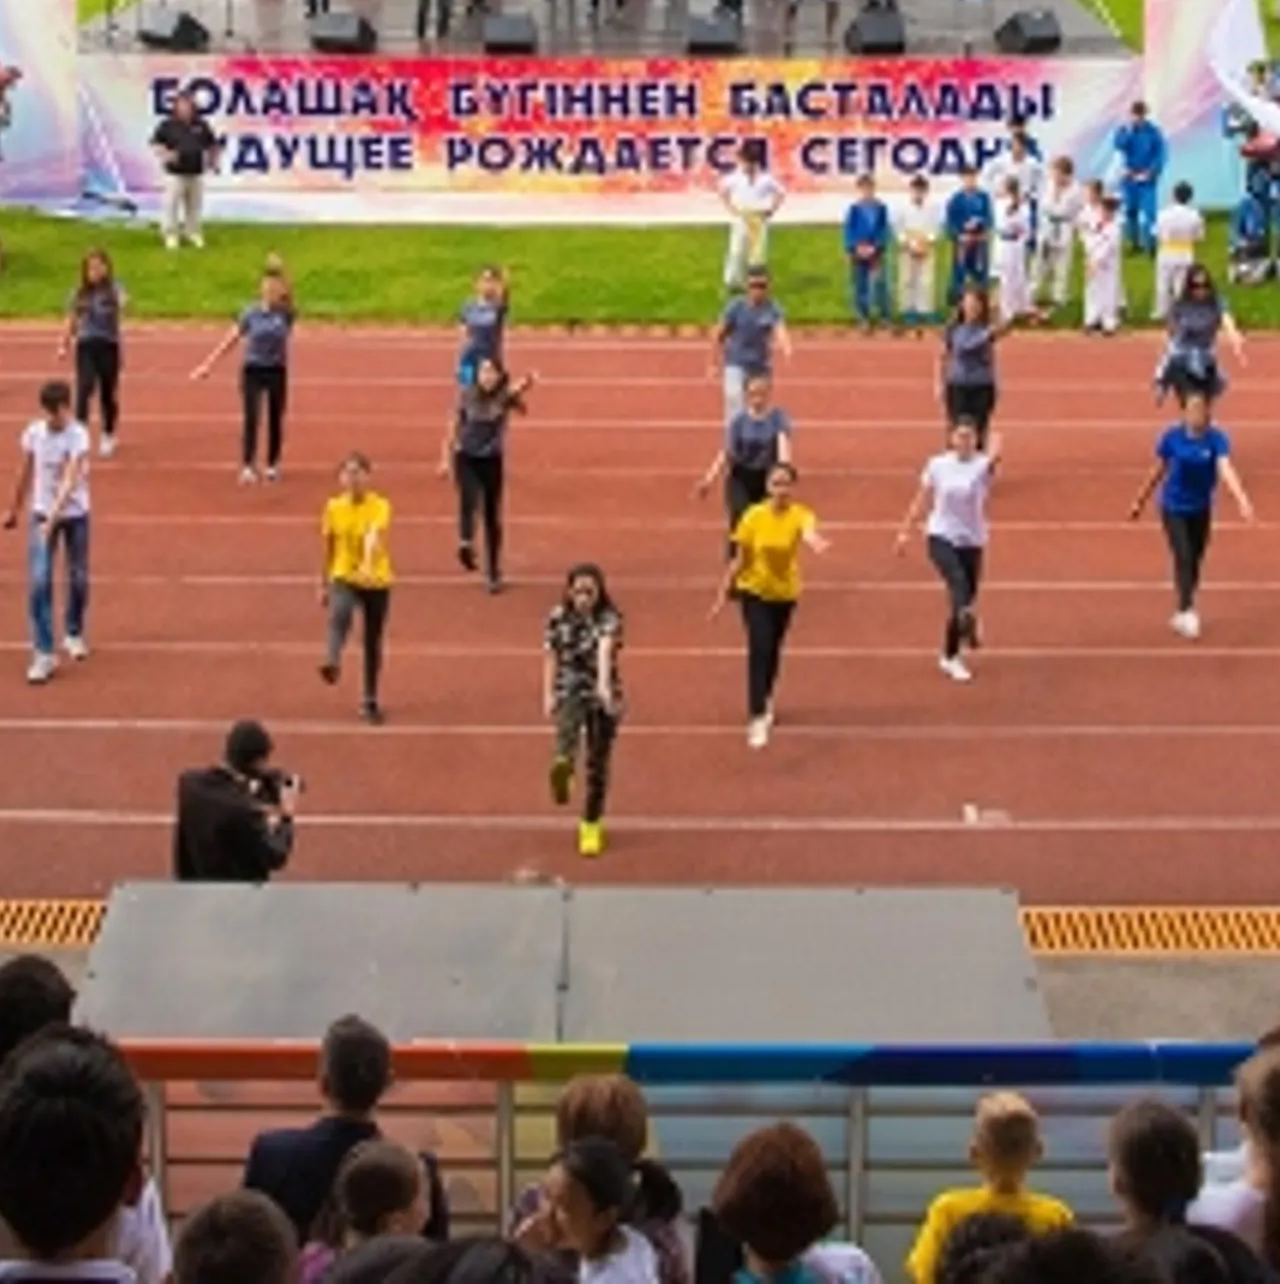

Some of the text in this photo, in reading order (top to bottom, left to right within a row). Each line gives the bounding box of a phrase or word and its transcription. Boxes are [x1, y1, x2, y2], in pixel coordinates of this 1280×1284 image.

[152, 78, 1055, 122] БОЛАШАҚ БҮГІННЕН БАСТАЛАДЫ
[212, 135, 414, 179] ДУЩЕЕ
[800, 136, 1016, 175] СЕГОДН
